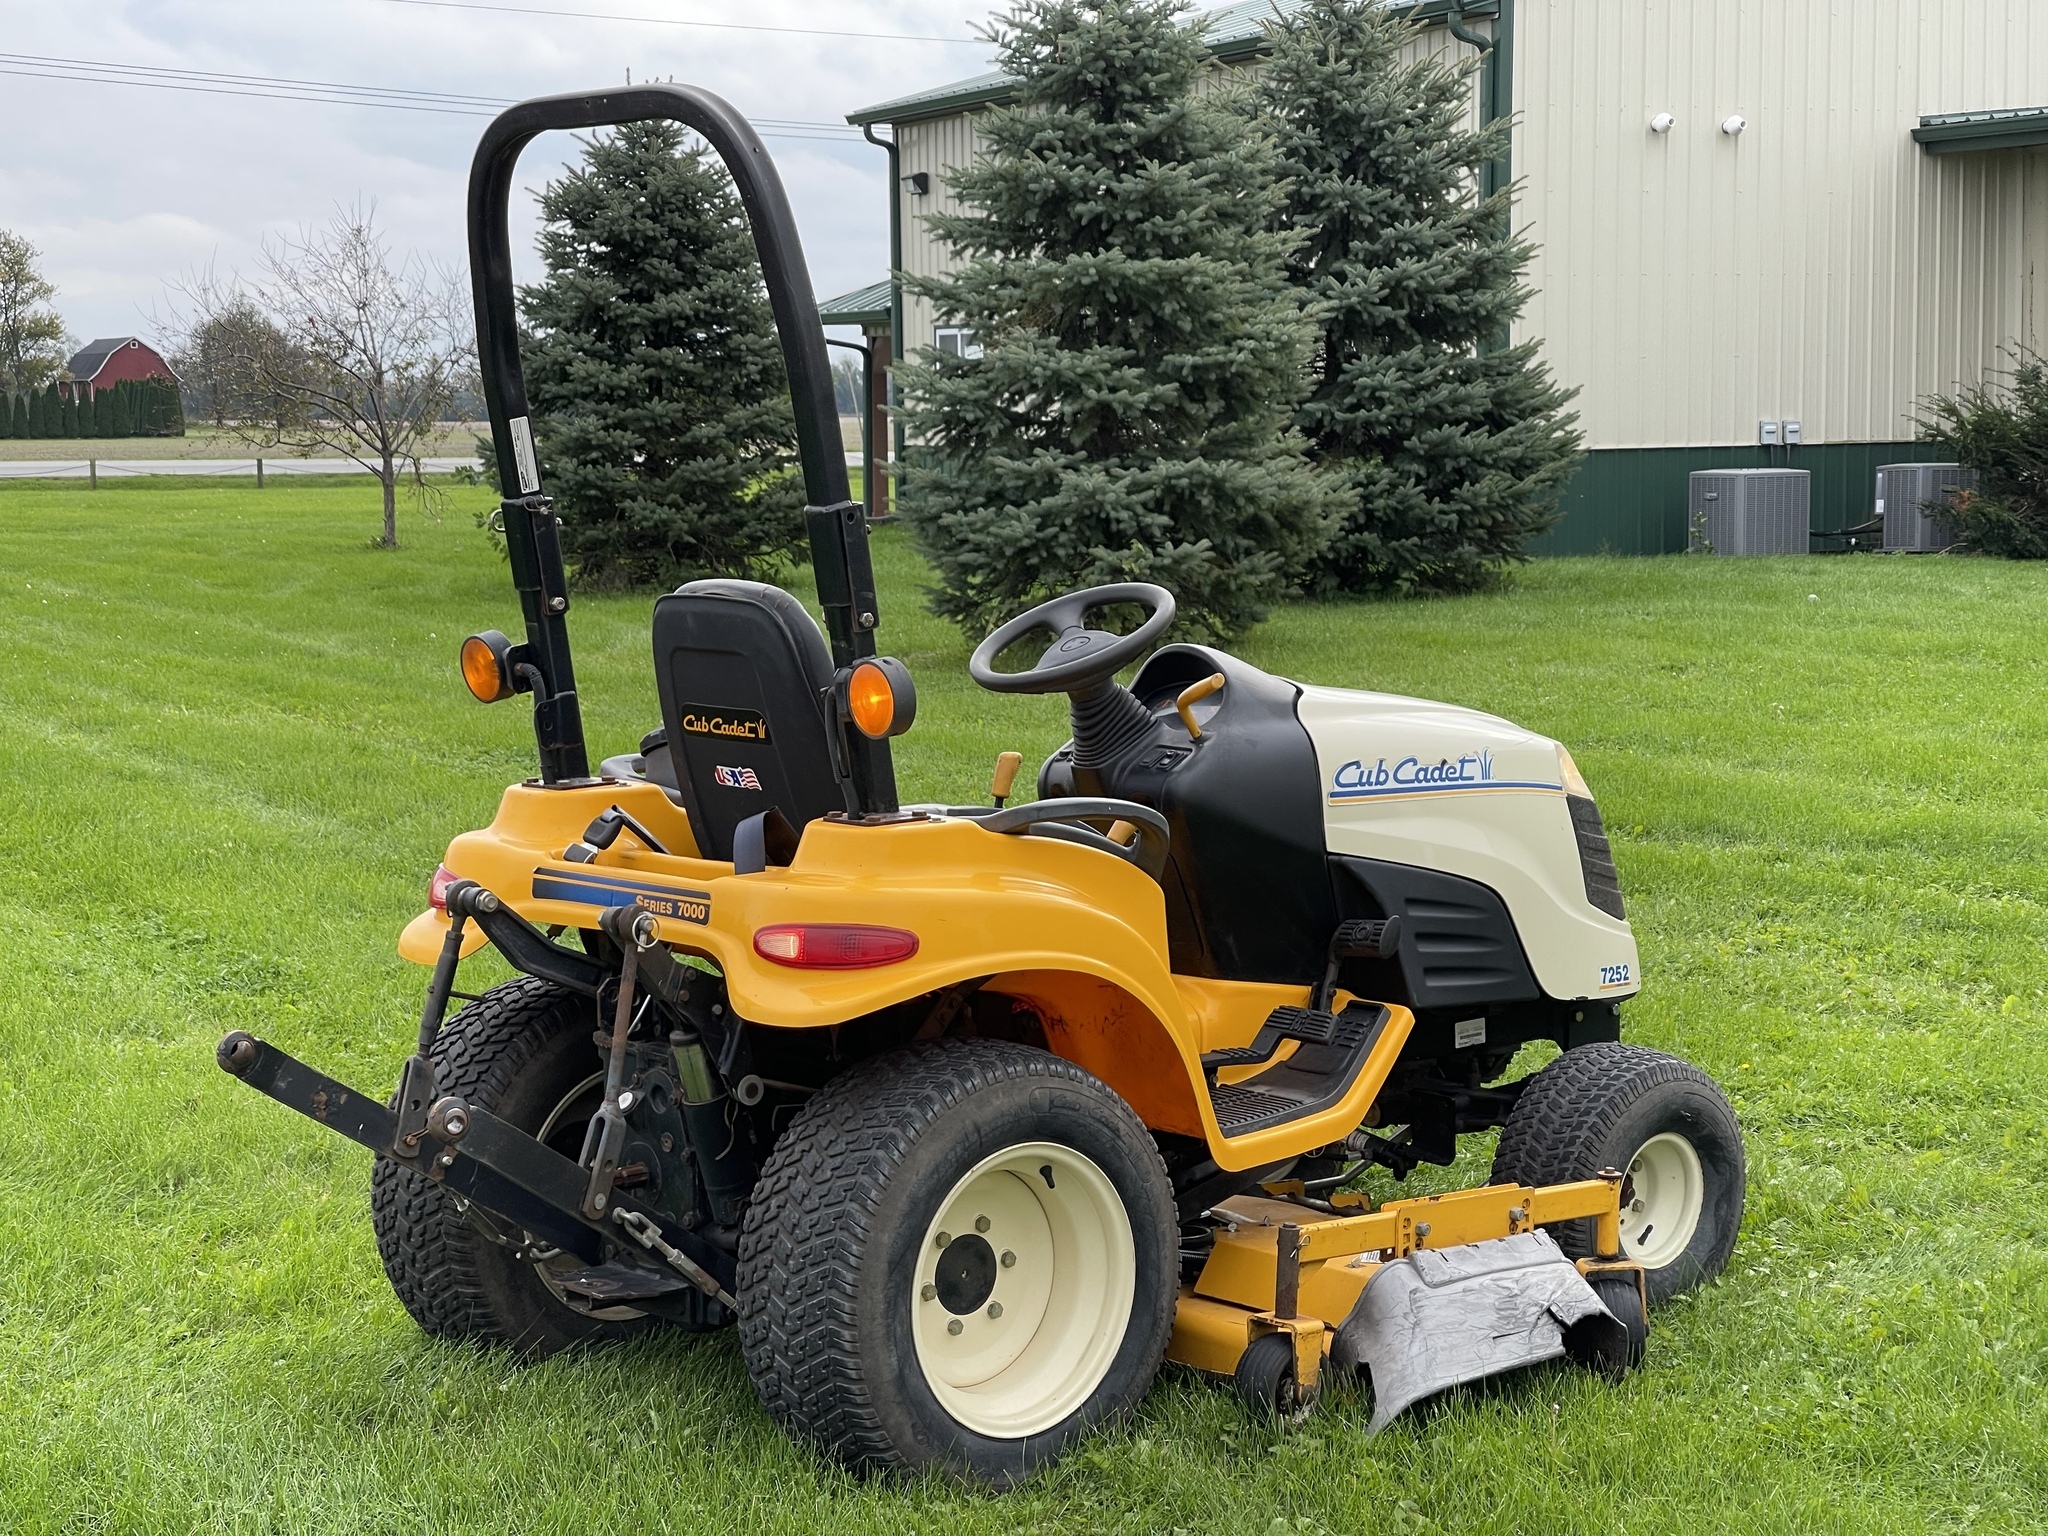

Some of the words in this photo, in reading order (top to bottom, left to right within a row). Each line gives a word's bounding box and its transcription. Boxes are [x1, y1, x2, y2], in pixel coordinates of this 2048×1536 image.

[683, 714, 709, 732] Cub
[710, 717, 756, 738] Cadet
[715, 765, 742, 787] USA
[1334, 759, 1389, 788] Cub
[1393, 756, 1477, 784] Cadet
[677, 902, 706, 920] 7000
[1600, 964, 1630, 984] 7252
